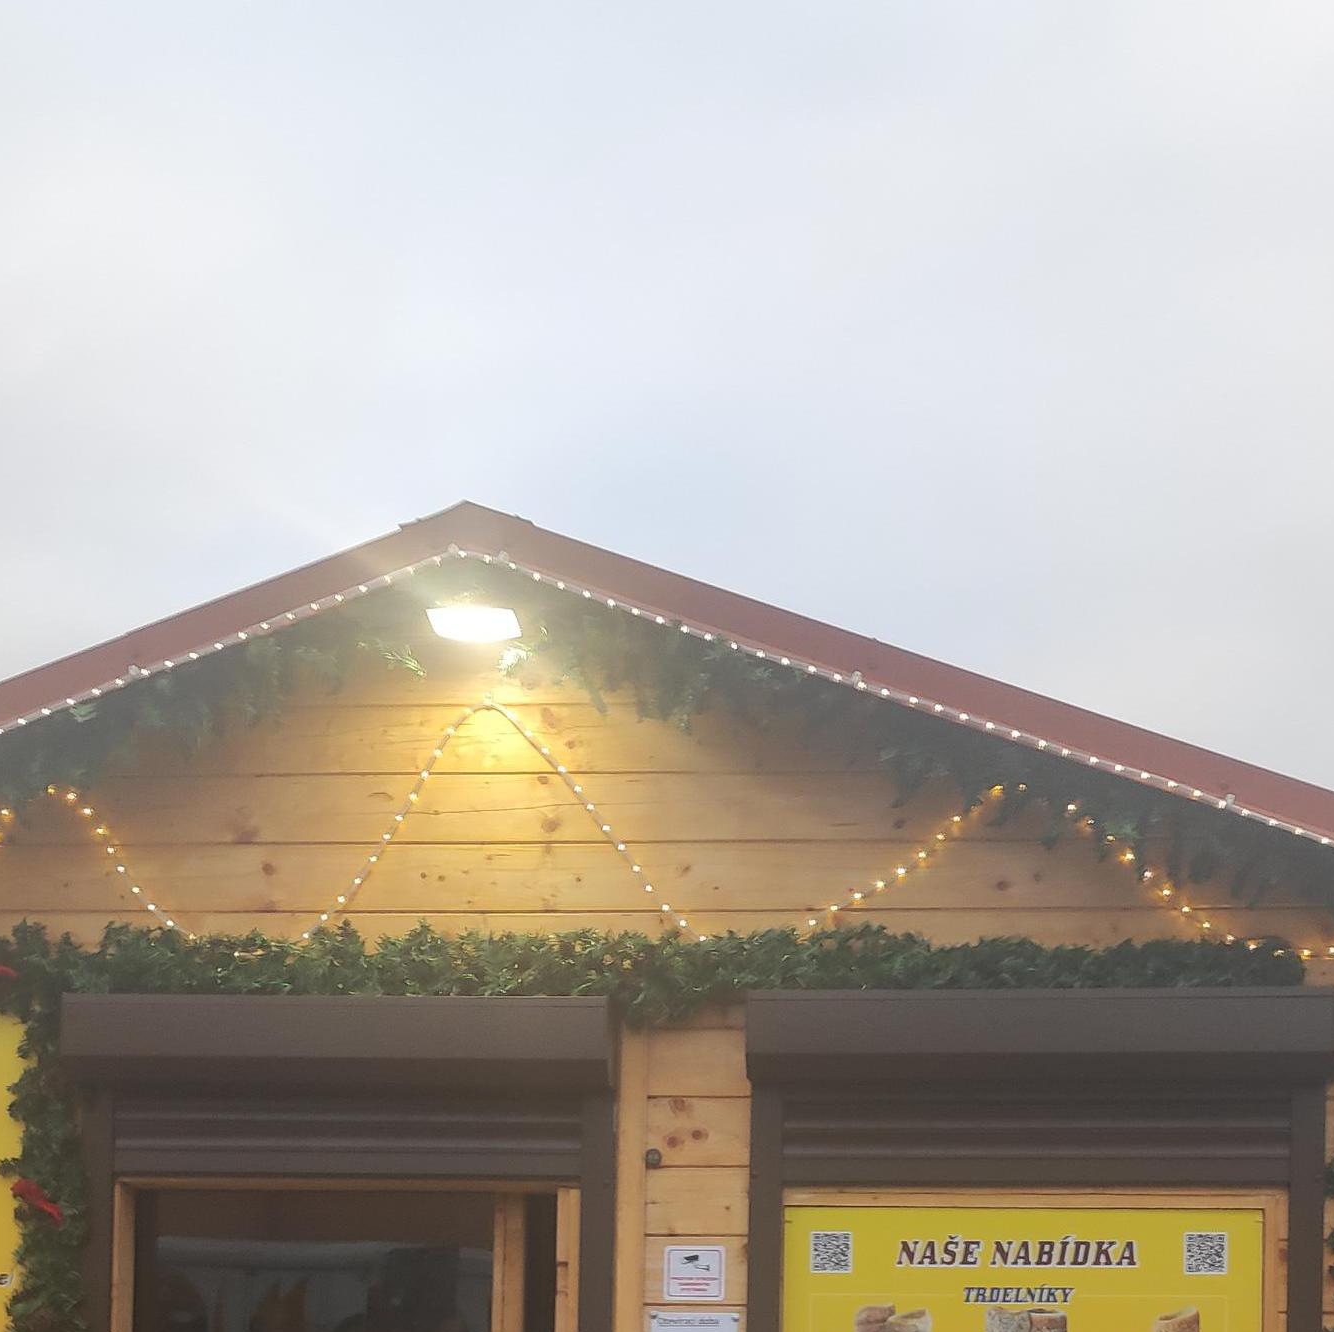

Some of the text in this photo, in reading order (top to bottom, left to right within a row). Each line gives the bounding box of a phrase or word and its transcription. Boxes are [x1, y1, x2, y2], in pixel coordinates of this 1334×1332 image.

[896, 1235, 1138, 1267] NAŠE NABÍDKA
[962, 1284, 1076, 1304] TRDELNÍKY
